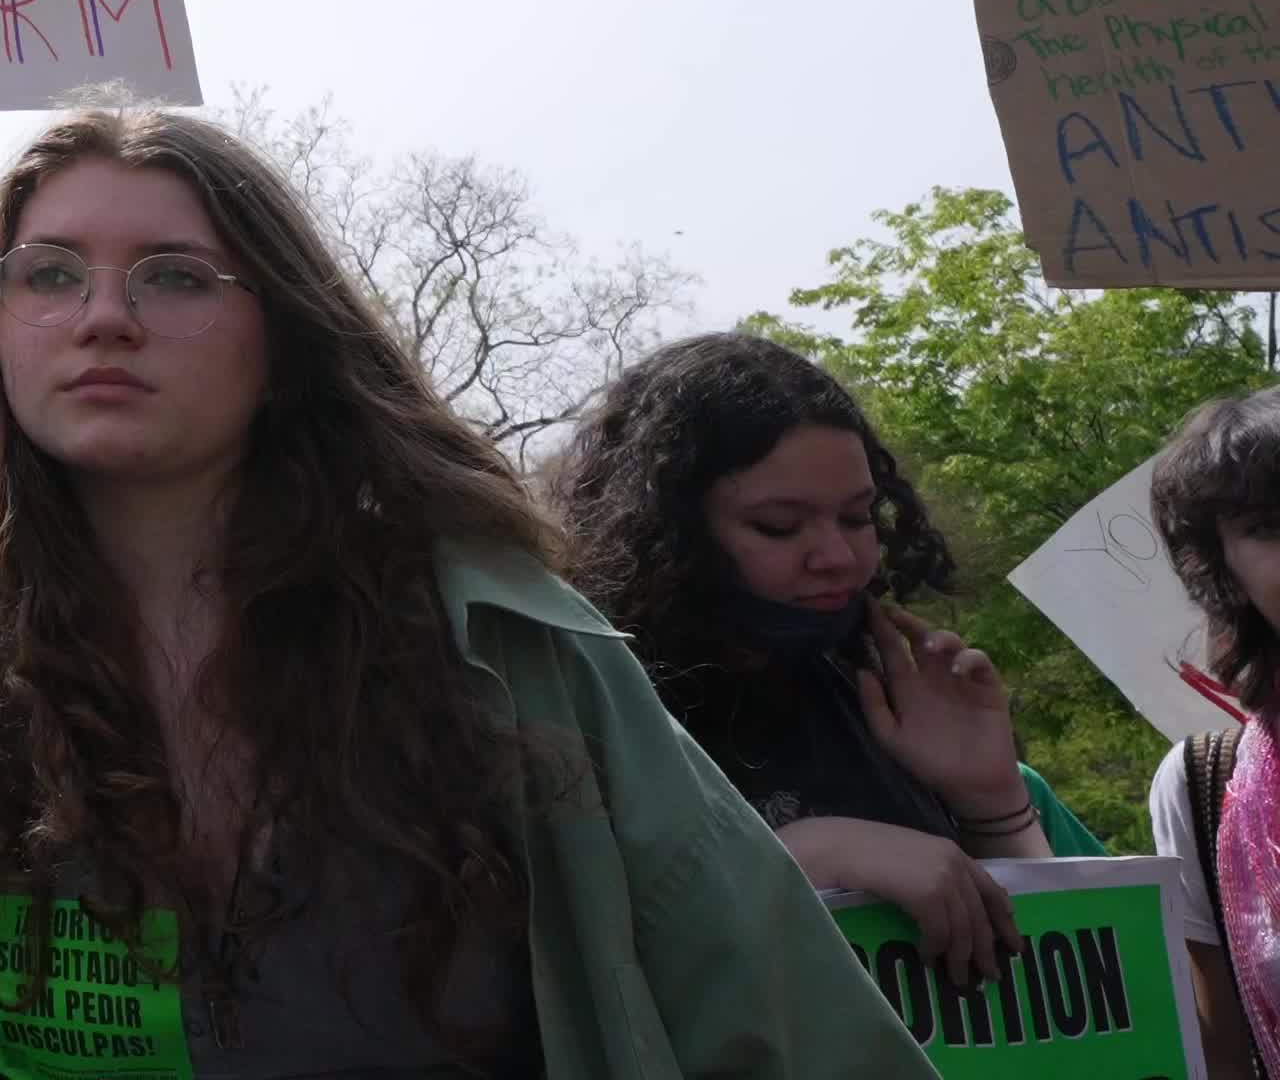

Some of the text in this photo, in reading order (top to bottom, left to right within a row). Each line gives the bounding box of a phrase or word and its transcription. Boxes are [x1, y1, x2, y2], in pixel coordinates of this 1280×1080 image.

[851, 925, 1133, 1048] ORTION
[65, 989, 142, 1029] PEDIR
[0, 1020, 157, 1058] DISCULPAS!
